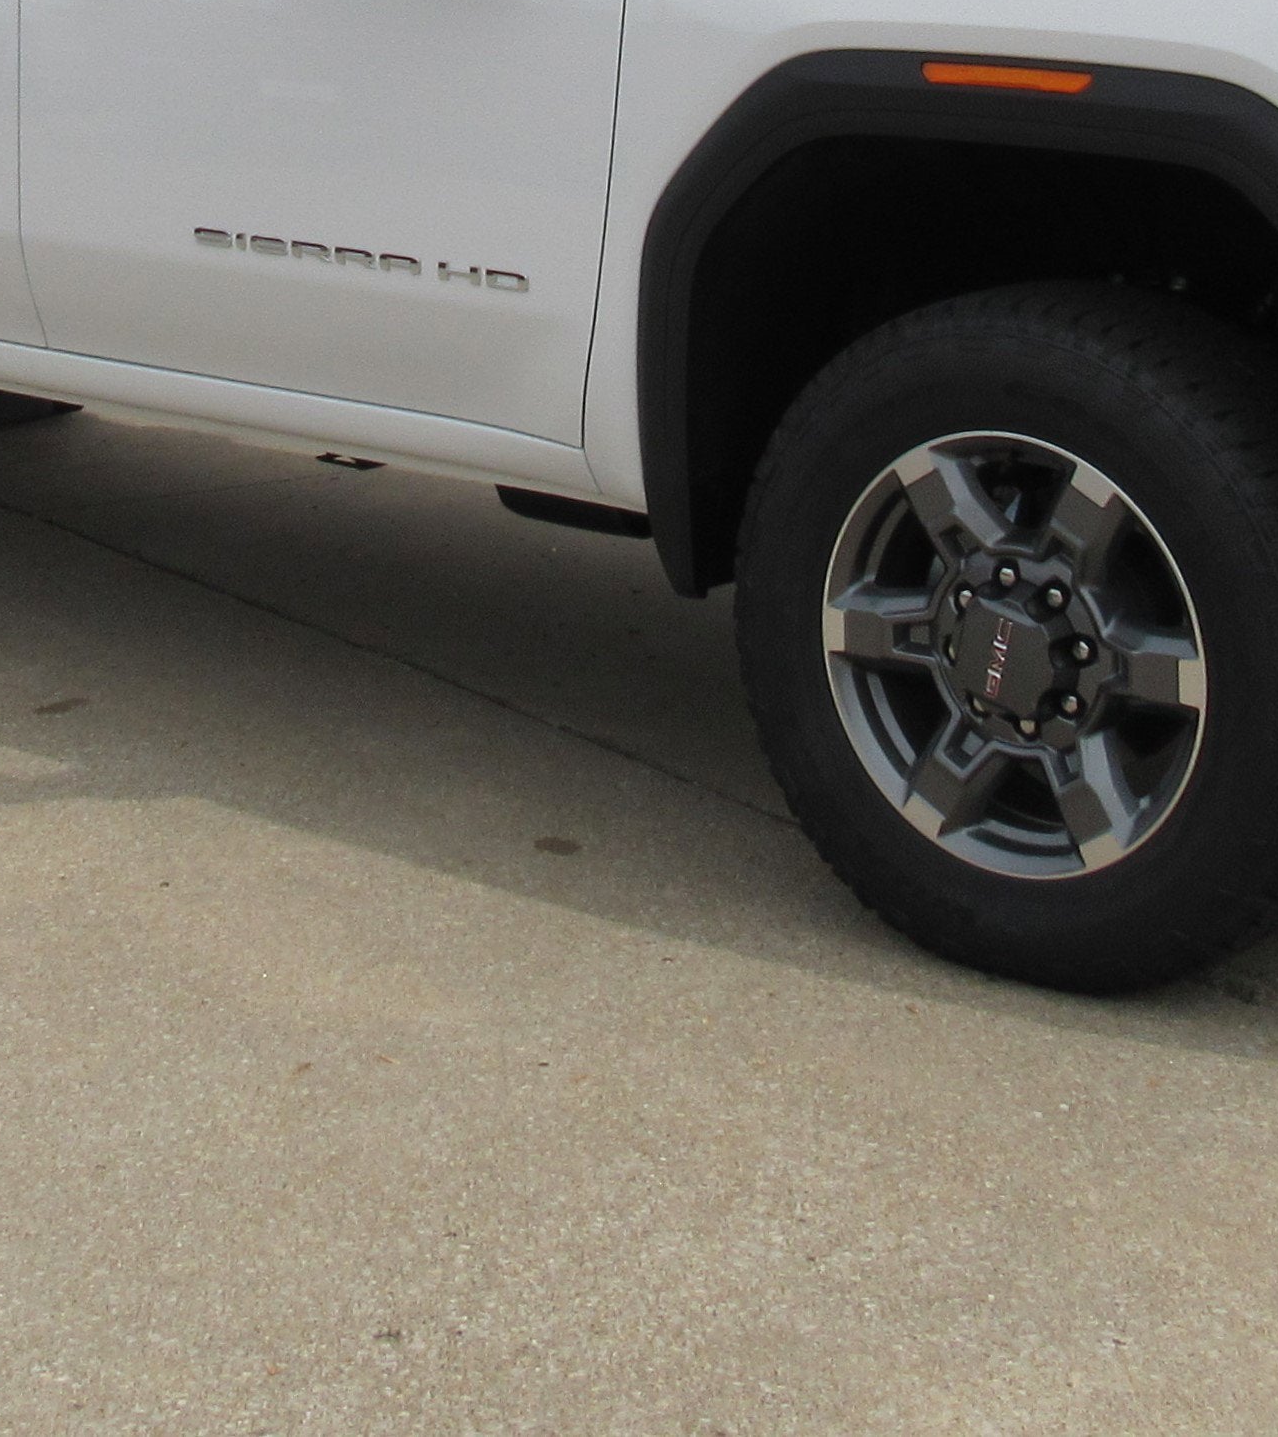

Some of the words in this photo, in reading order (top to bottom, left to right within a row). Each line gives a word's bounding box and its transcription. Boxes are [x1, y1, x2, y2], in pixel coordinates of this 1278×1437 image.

[193, 227, 422, 275] SIERRA
[437, 261, 529, 293] HD
[984, 617, 1013, 699] GMC
